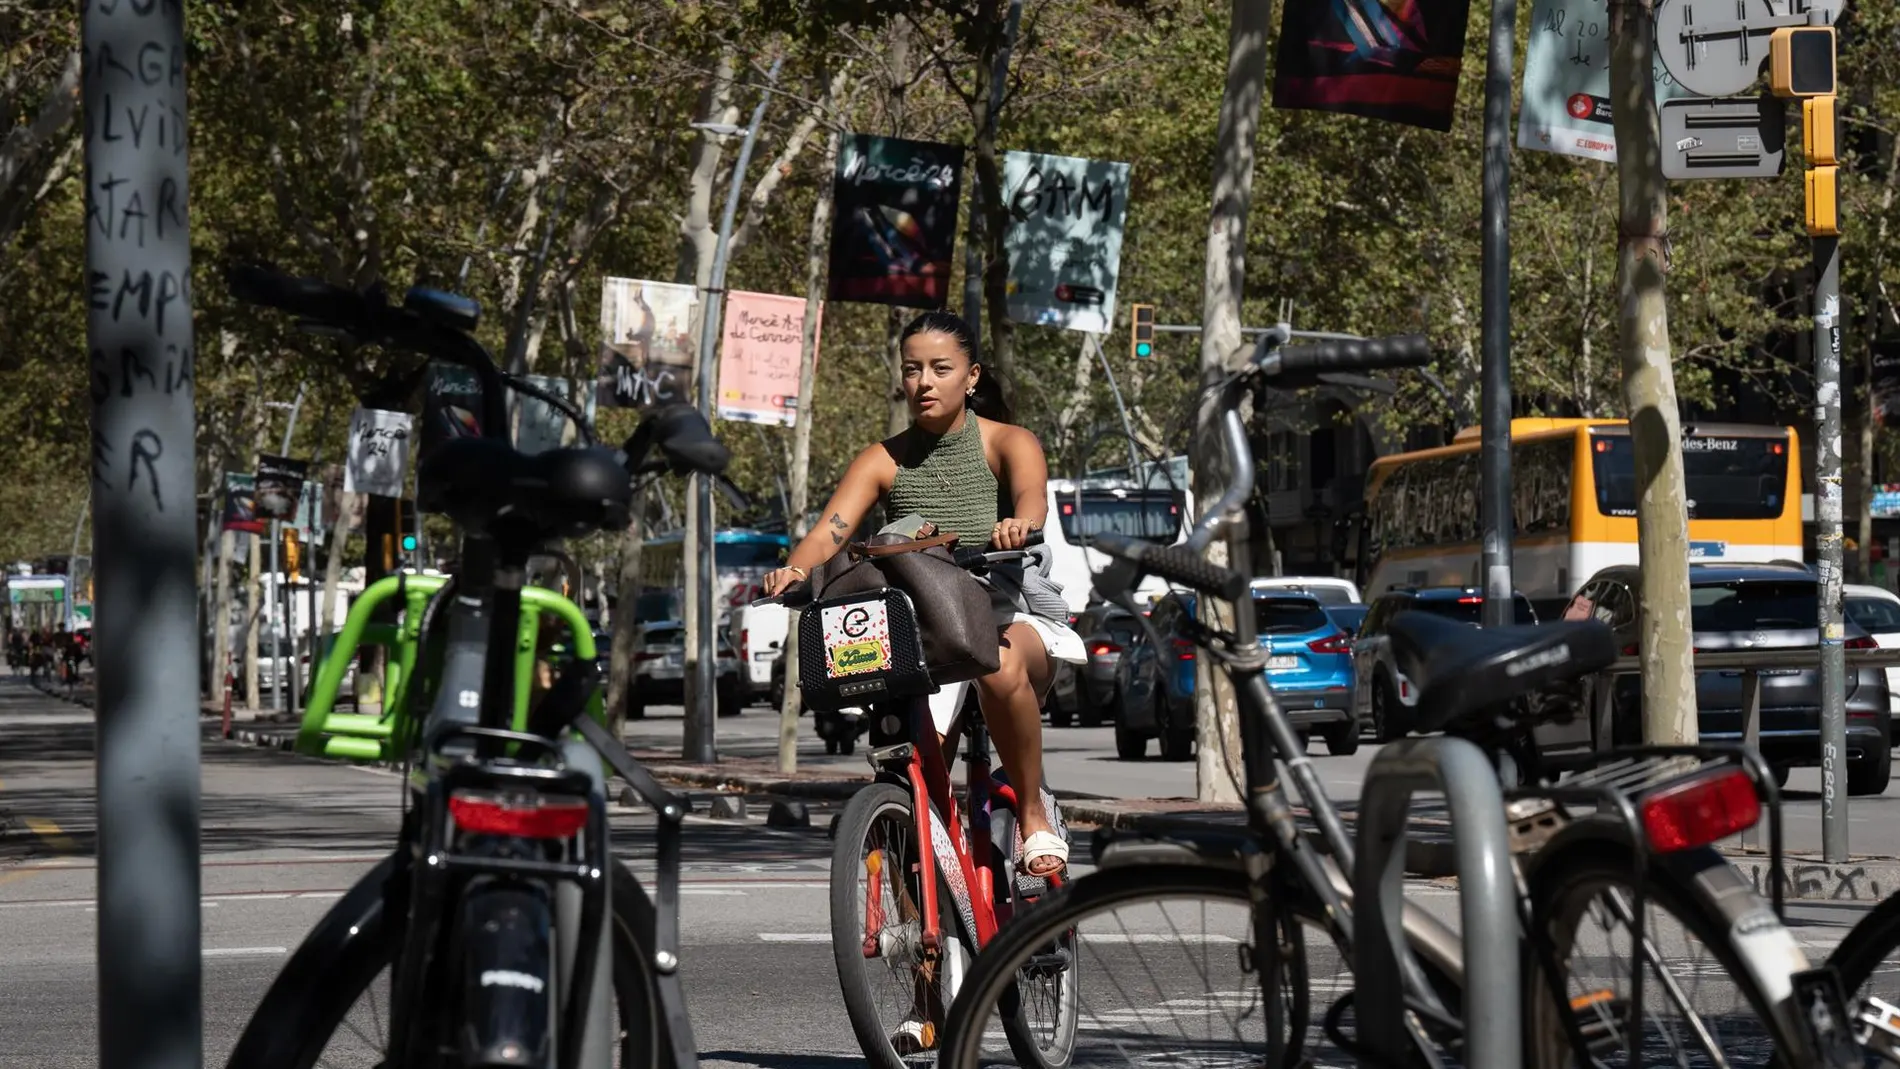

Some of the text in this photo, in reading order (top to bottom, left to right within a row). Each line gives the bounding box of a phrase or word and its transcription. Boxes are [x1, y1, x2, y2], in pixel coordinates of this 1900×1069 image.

[1595, 108, 1612, 117] Barc
[1010, 164, 1113, 222] BAM
[617, 365, 675, 404] MAC
[1681, 437, 1738, 450] des-Benz
